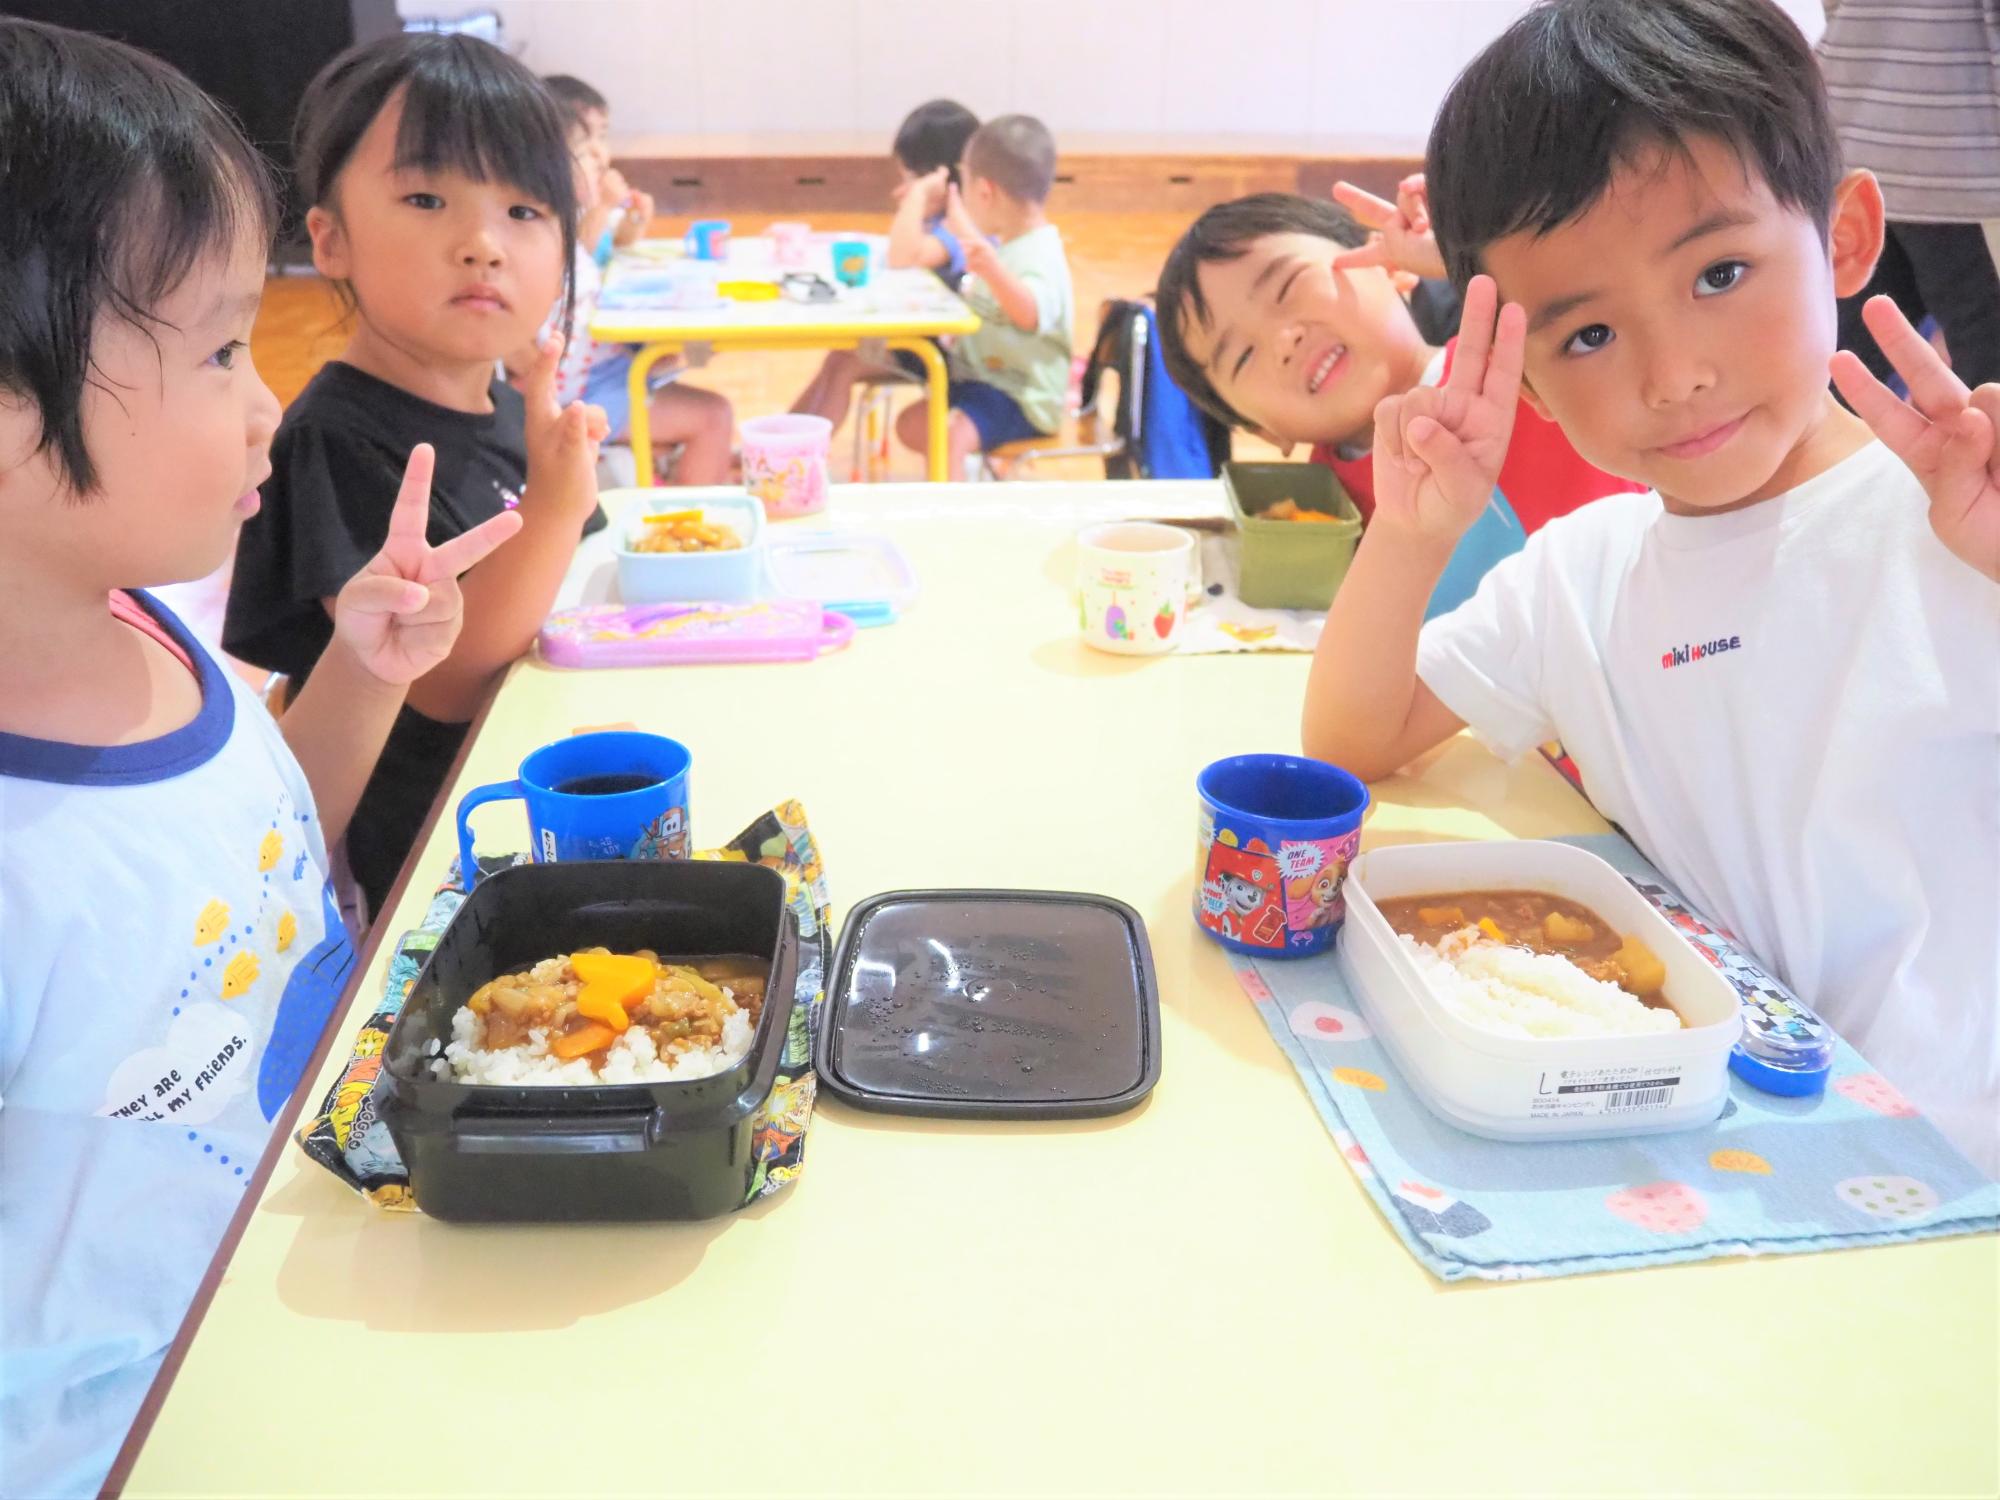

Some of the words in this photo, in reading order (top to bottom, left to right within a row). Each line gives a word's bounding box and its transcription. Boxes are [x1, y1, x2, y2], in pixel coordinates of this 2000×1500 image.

[1691, 635, 1741, 662] HOUSE
[1287, 849, 1307, 860] ONE
[1290, 856, 1315, 869] TEAM
[1539, 1071, 1553, 1095] L
[137, 1110, 165, 1122] LL
